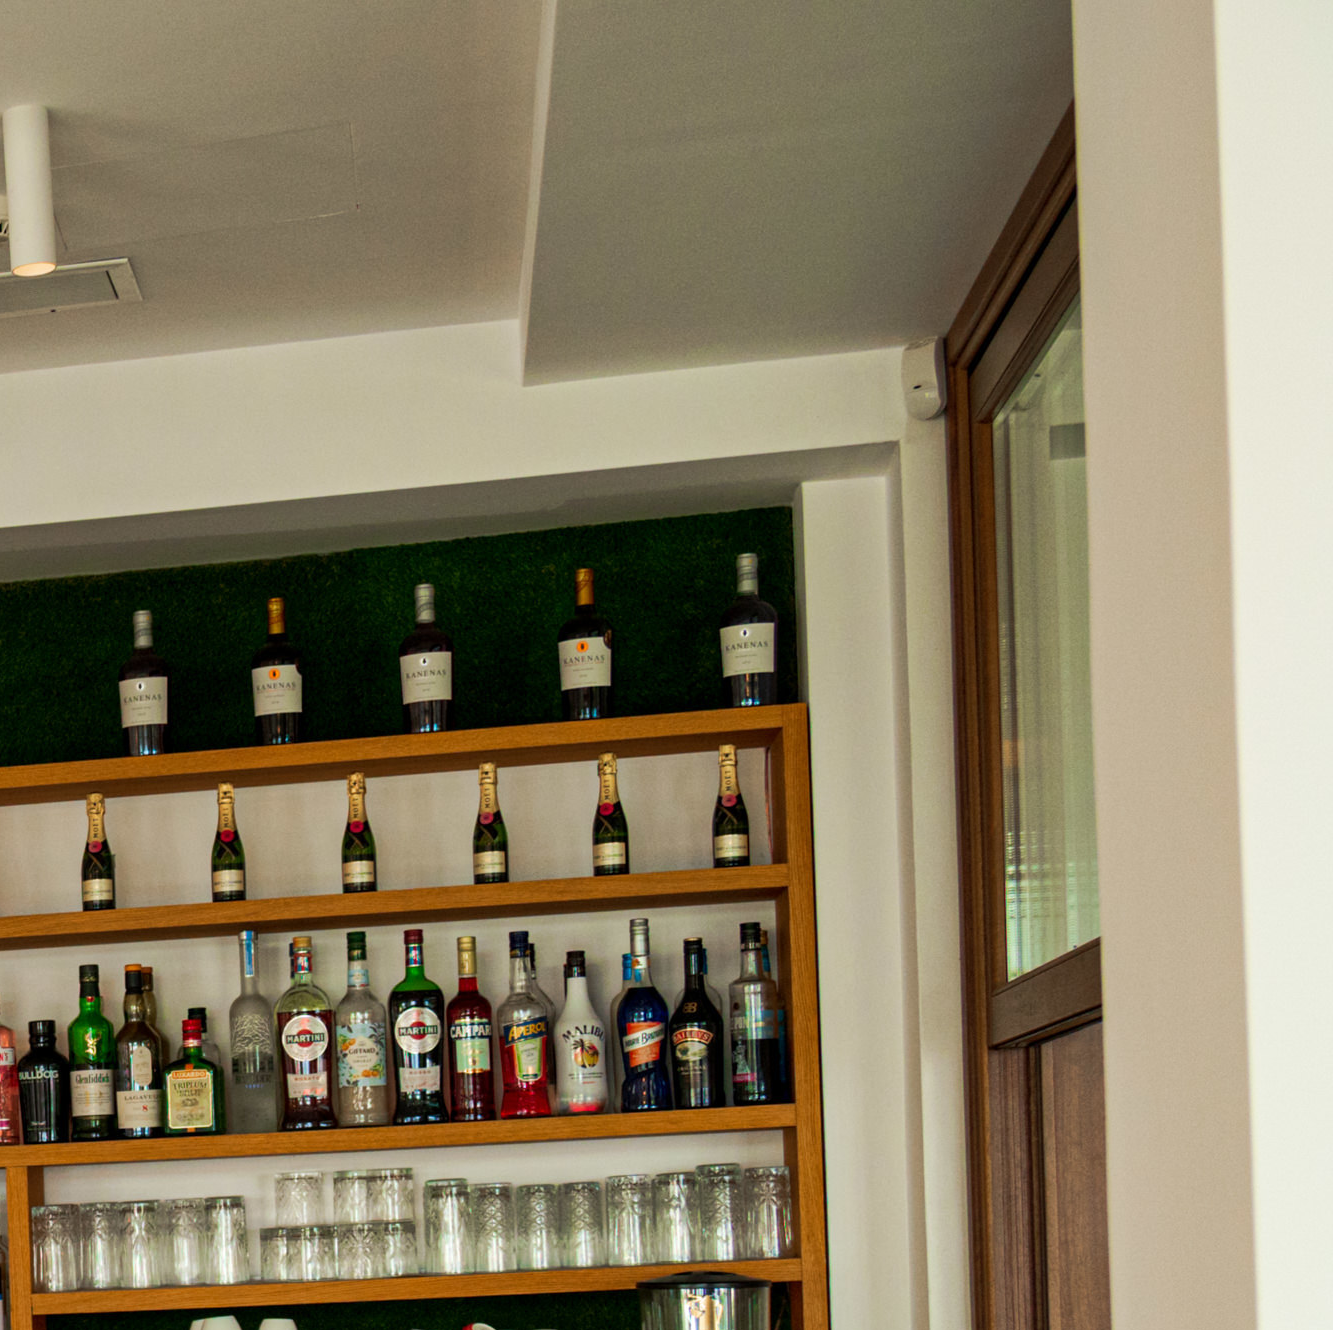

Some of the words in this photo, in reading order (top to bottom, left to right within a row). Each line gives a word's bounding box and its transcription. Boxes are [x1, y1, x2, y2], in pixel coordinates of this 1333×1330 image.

[725, 641, 768, 651] KANENAS
[563, 655, 605, 664] KANENAS
[406, 670, 446, 679] KANENAS
[257, 682, 296, 691] KANENAS
[124, 695, 162, 704] KANENAS
[399, 1026, 438, 1035] MARTINI
[450, 1023, 491, 1038] CAMPAR
[508, 1022, 545, 1042] APEROL
[563, 1024, 604, 1044] MALIBU
[286, 1033, 325, 1043] MARTINI
